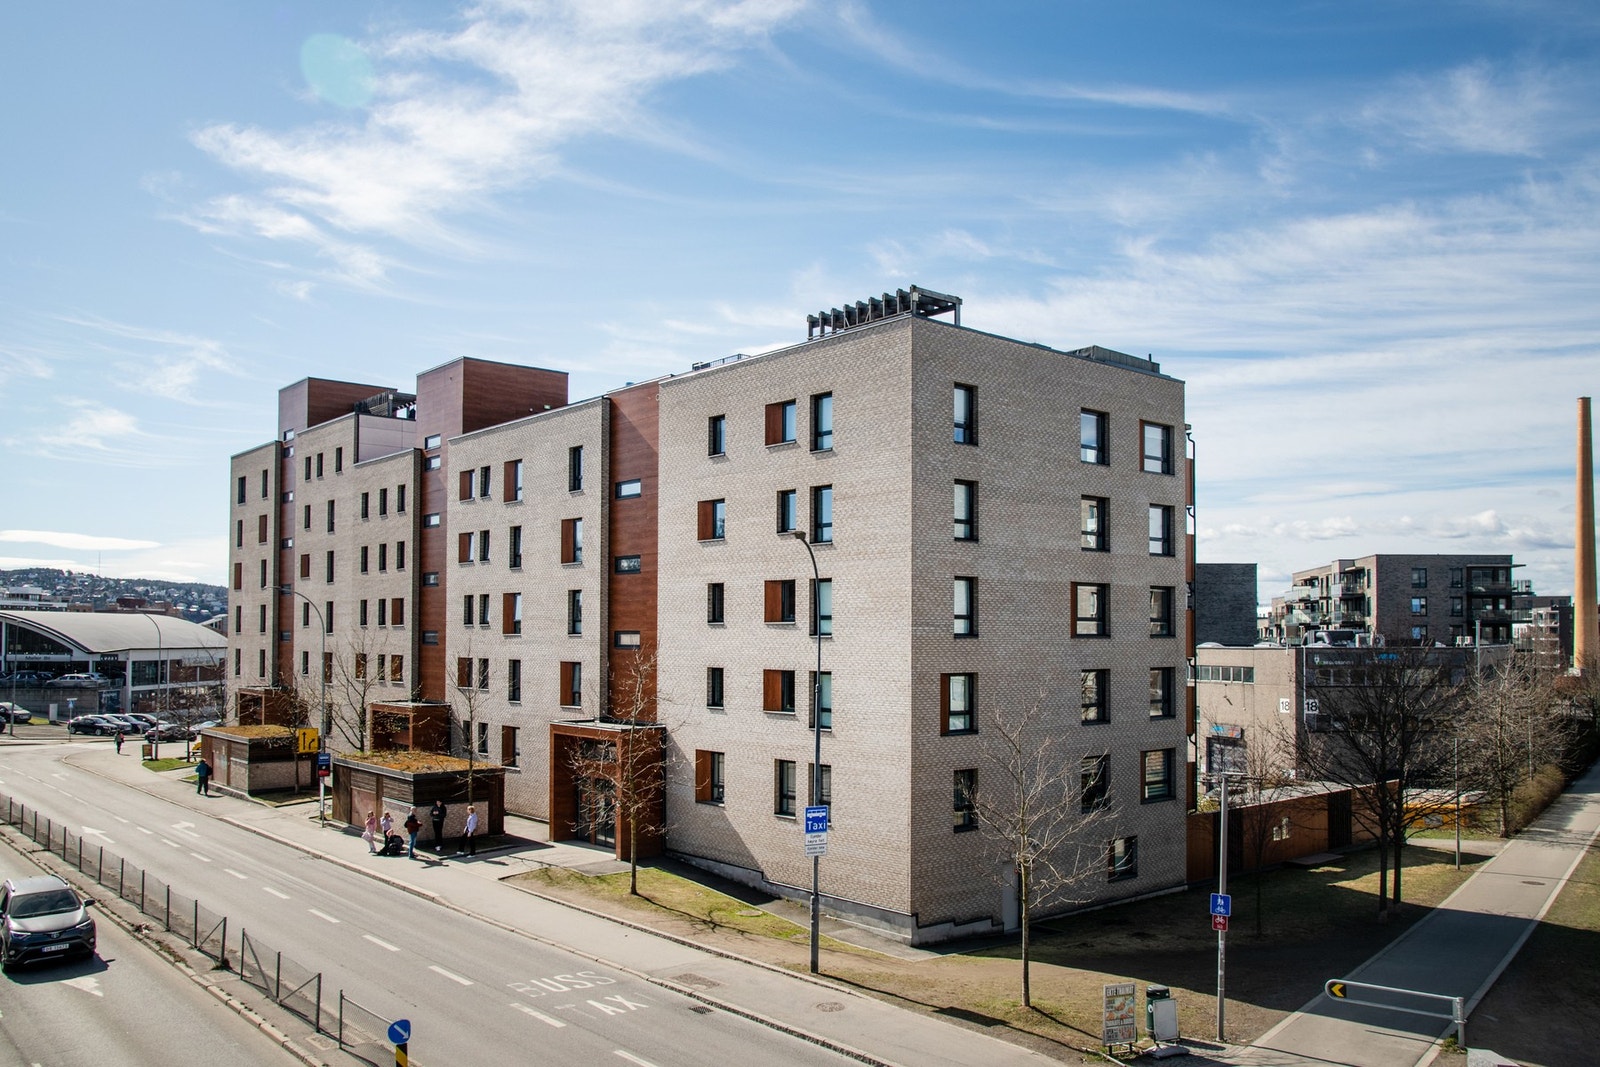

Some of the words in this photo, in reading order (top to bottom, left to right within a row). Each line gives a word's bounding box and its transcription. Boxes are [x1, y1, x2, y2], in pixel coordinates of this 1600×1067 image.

[1281, 701, 1290, 711] 18
[1305, 701, 1318, 712] 18
[807, 820, 826, 830] Taxi
[506, 971, 616, 997] BUSS
